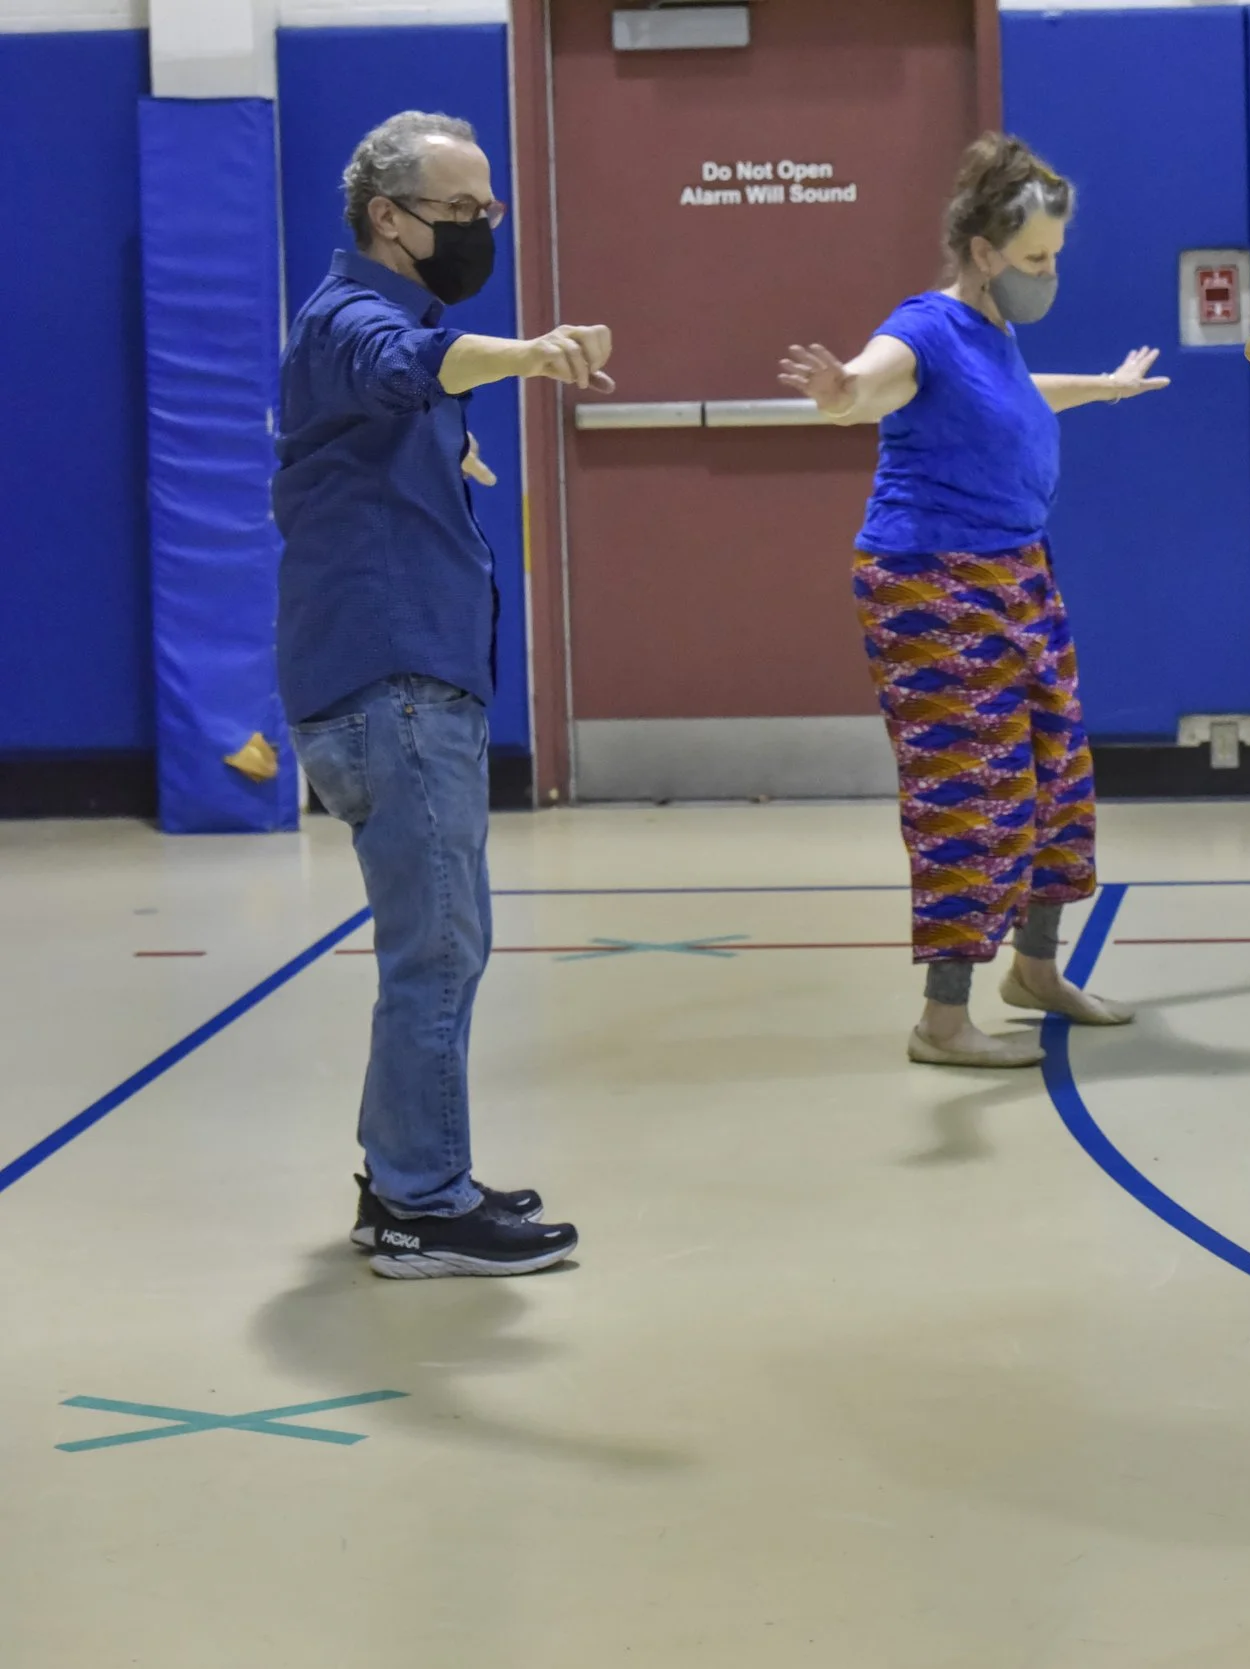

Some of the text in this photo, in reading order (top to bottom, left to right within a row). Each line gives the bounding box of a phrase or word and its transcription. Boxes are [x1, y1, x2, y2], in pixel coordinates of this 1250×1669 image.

[702, 160, 833, 181] Do Not Open
[680, 183, 857, 205] Alarm Will Sound
[381, 1229, 420, 1249] HOKA
